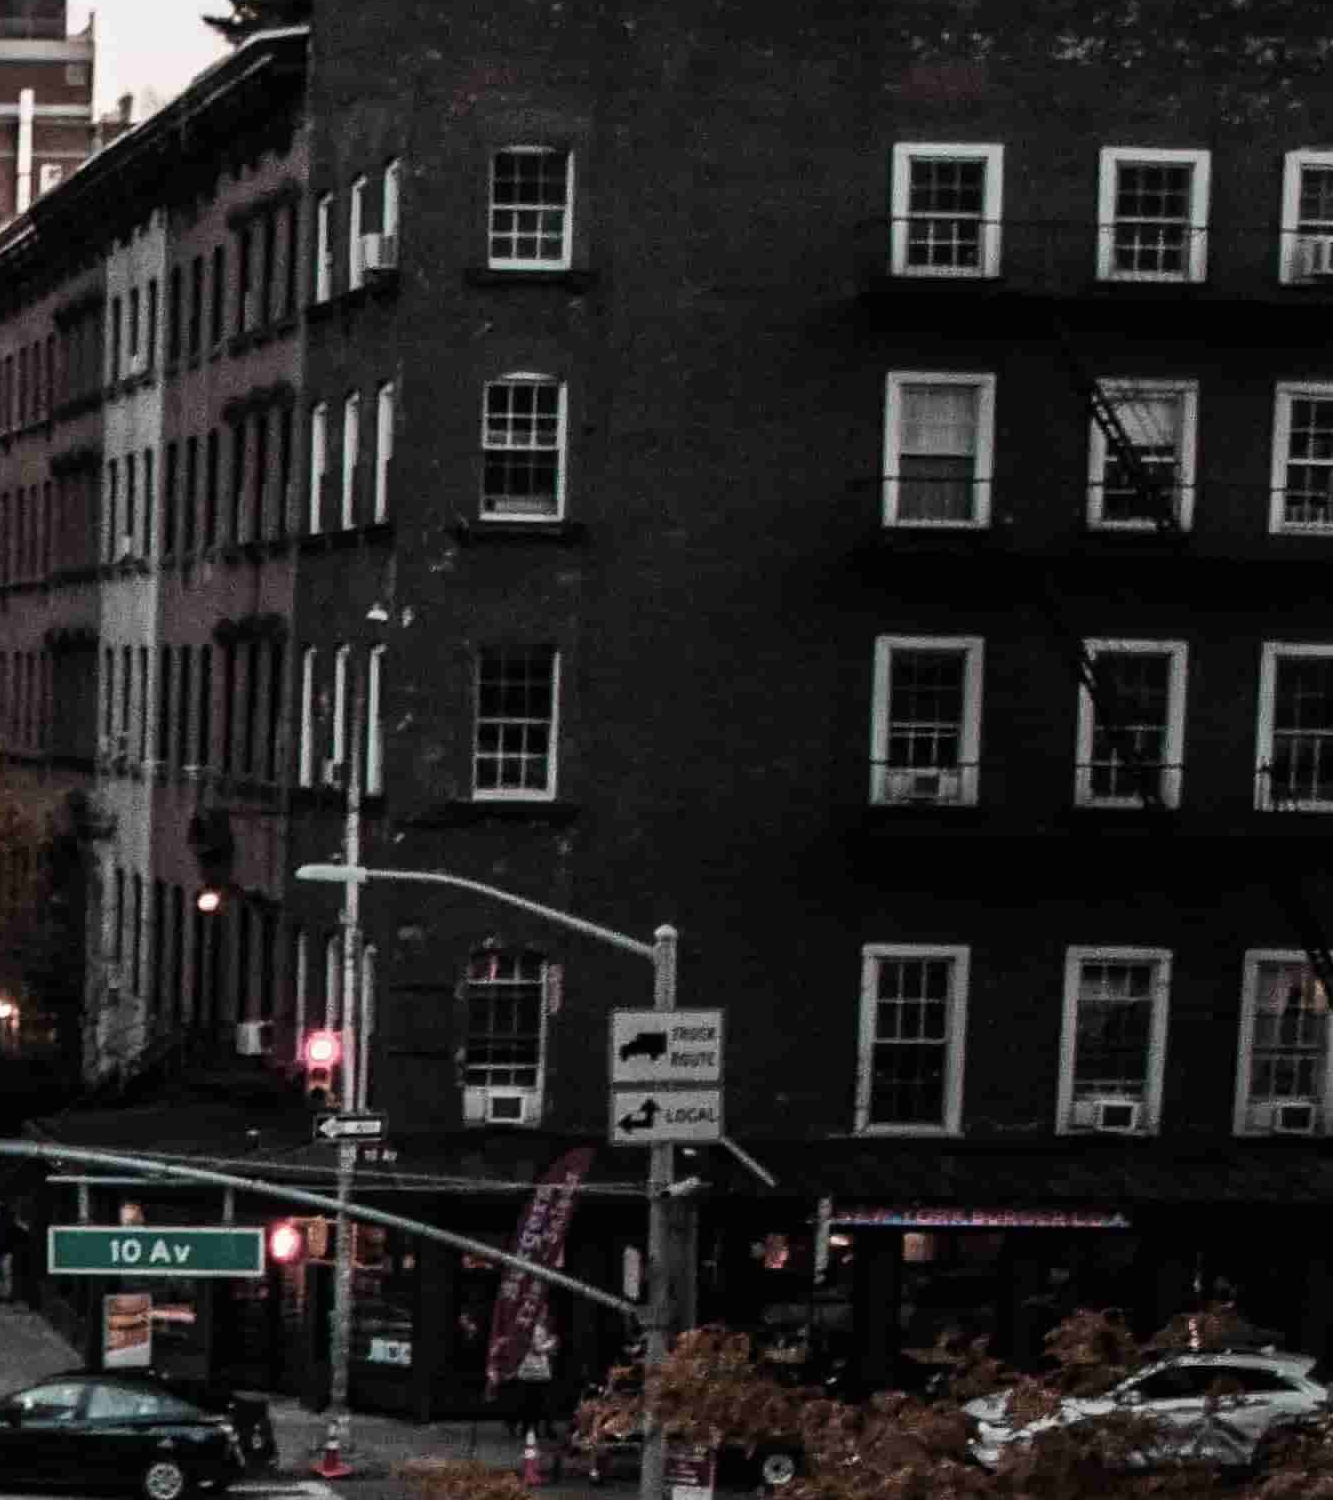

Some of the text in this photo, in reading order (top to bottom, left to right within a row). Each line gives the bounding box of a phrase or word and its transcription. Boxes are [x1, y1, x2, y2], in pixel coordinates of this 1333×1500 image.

[671, 1027, 715, 1042] TRUCK
[671, 1052, 715, 1067] ROUTE
[665, 1108, 717, 1123] LOCAL
[109, 1238, 191, 1263] 10 Av
